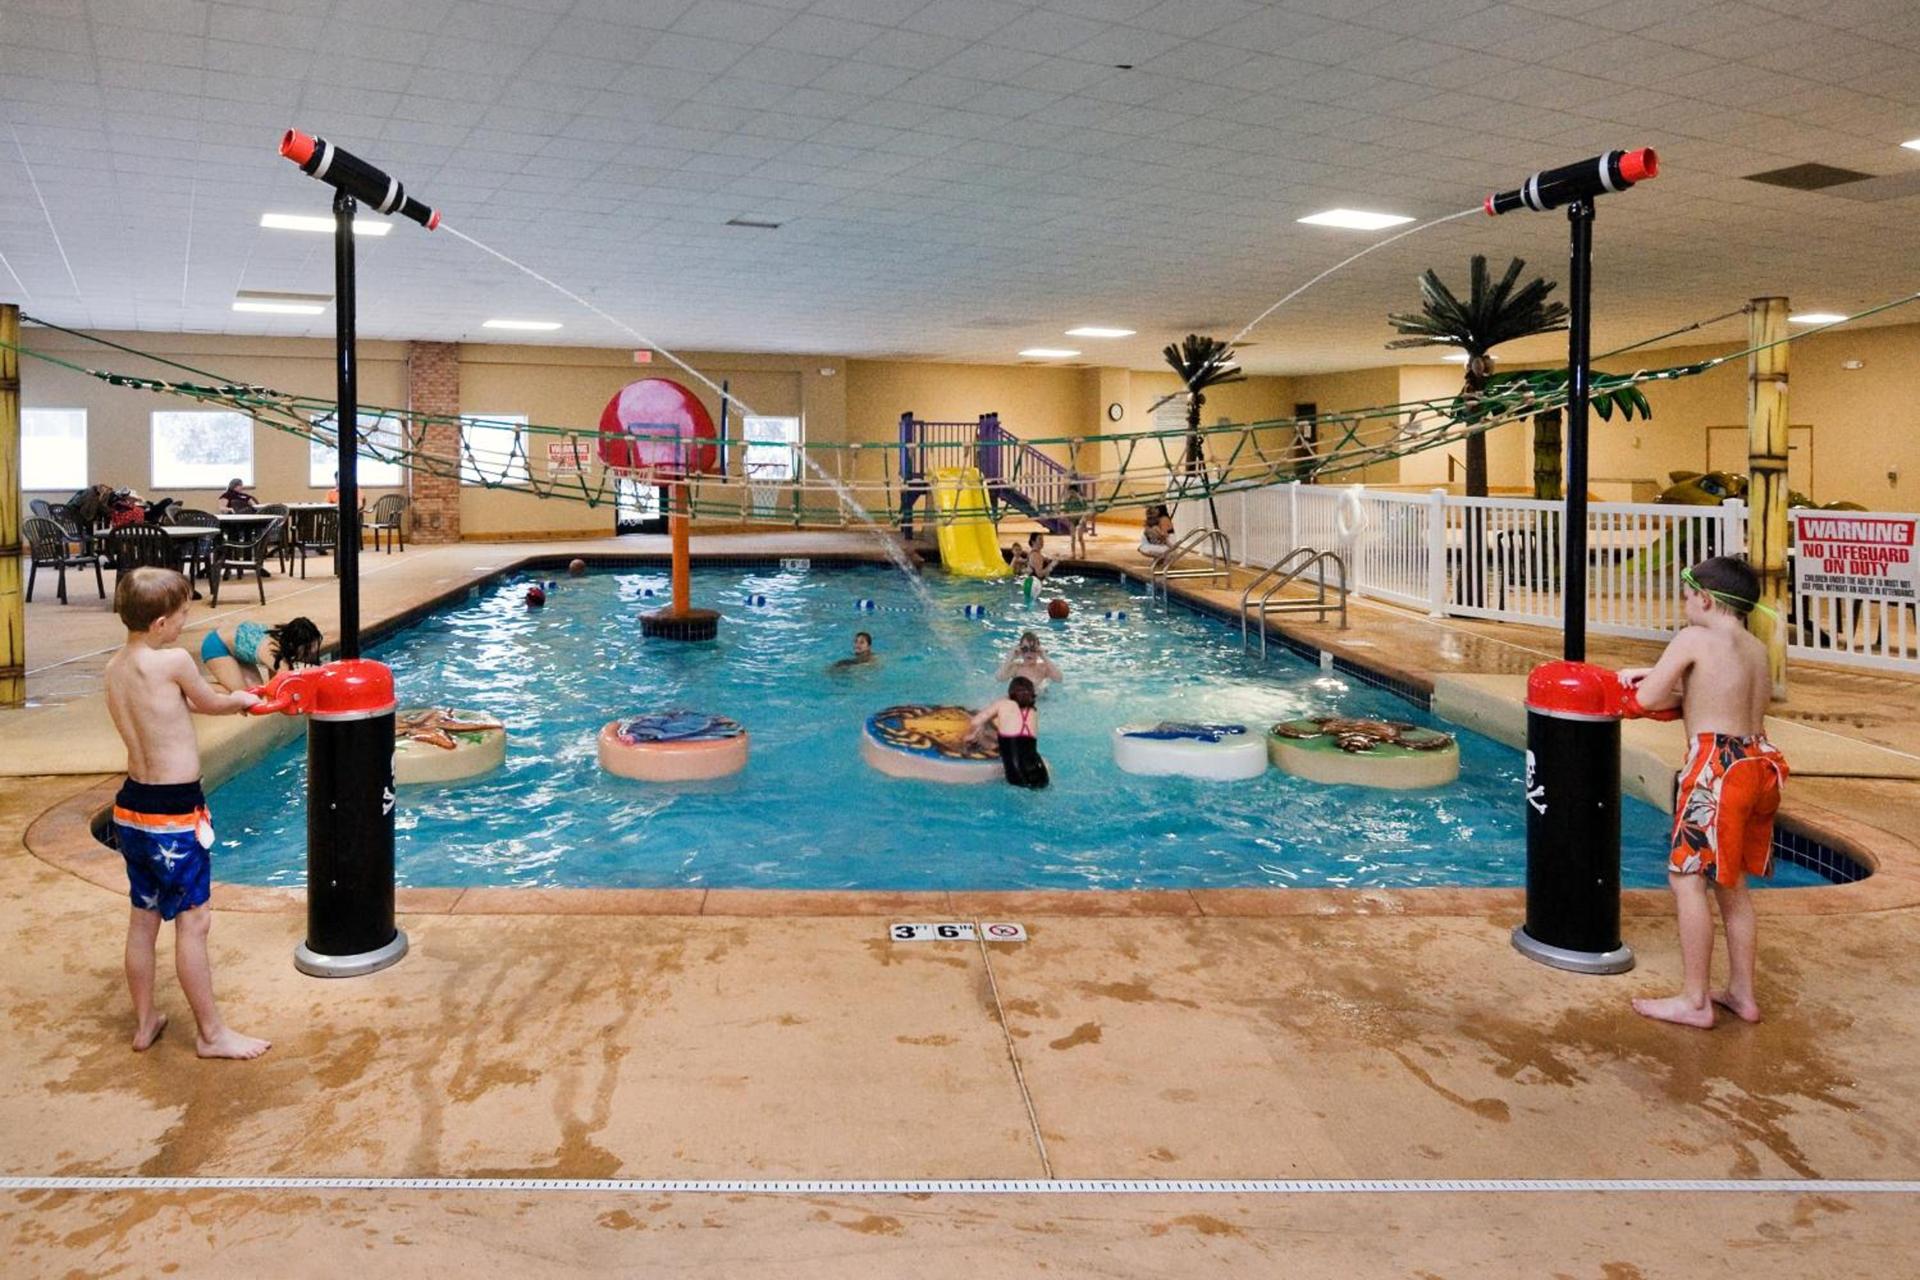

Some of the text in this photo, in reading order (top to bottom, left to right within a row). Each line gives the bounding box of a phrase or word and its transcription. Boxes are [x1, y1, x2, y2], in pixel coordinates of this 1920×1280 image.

[1804, 520, 1908, 543] WARNING
[1803, 543, 1909, 563] NO LIFEGUARD
[1824, 559, 1889, 577] ON DUTY
[1804, 574, 1827, 583] CHILDREN
[1829, 576, 1846, 584] UNDER
